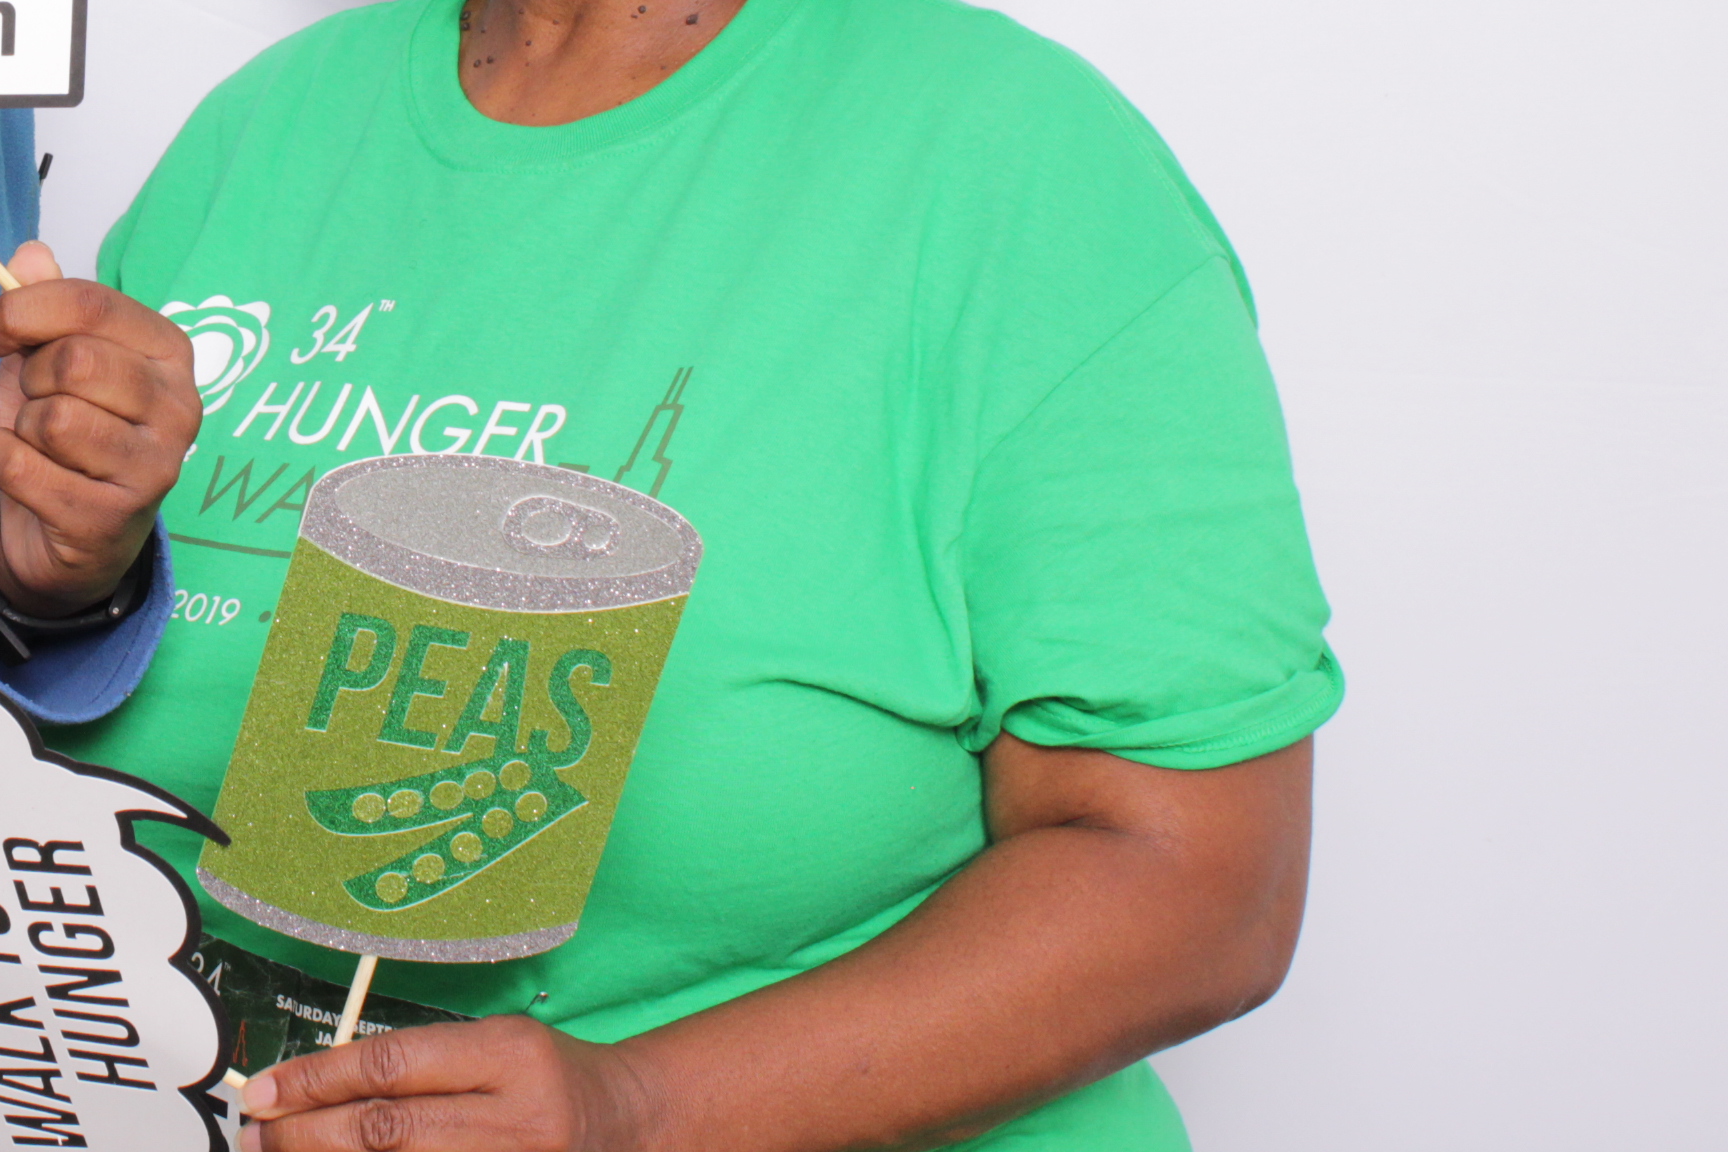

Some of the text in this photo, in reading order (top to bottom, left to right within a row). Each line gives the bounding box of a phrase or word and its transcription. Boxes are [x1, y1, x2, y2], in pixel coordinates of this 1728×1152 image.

[233, 381, 567, 466] HUNGER
[198, 454, 316, 525] WA
[171, 589, 242, 626] 2019
[304, 612, 614, 769] PEAS
[3, 837, 158, 1092] HUNGER
